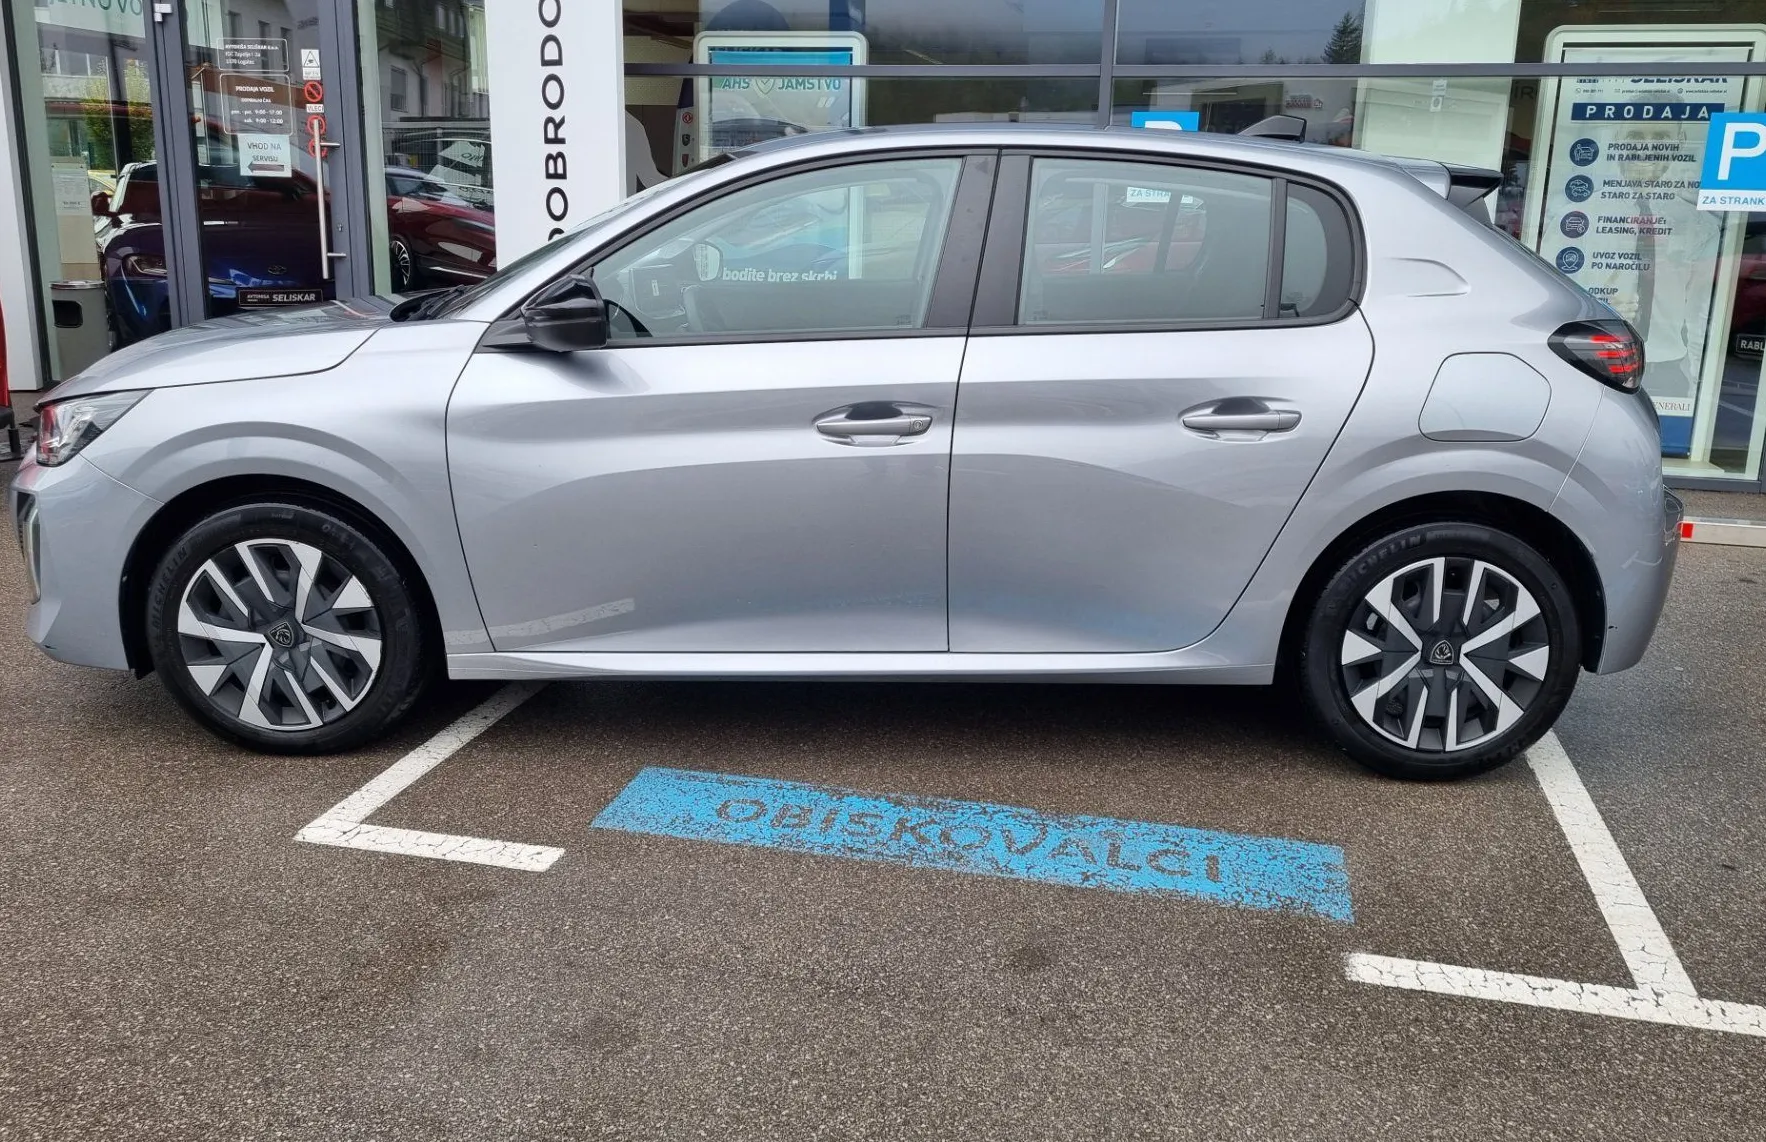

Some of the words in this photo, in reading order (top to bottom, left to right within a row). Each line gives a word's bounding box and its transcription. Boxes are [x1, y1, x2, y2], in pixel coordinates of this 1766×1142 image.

[722, 77, 750, 90] AHS
[777, 77, 842, 91] JAMSTVO
[1585, 105, 1710, 119] PRODAJA
[247, 142, 268, 150] VHOD
[270, 142, 282, 151] NA
[1607, 142, 1650, 152] PRODAJA
[1651, 143, 1680, 152] NOVIH
[1717, 122, 1766, 181] P
[1606, 154, 1616, 162] IN
[1618, 154, 1670, 162] RABLJENIH
[1672, 154, 1697, 162] VOZIL
[1602, 179, 1642, 188] MENJAVA
[1644, 180, 1673, 188] STARO
[1674, 180, 1686, 188] ZA
[1687, 180, 1701, 189] NO
[1600, 191, 1630, 199] STARO
[1632, 192, 1643, 200] ZA
[1644, 192, 1675, 200] STARO
[1702, 196, 1716, 204] ZA
[1719, 196, 1766, 206] STRANK
[1597, 215, 1667, 224] FINANCIRANJE:
[1596, 227, 1637, 236] LEASING,
[1639, 227, 1673, 236] KREDIT
[1592, 252, 1616, 260] UVOZ
[1617, 252, 1642, 260] VOZIL
[1591, 262, 1603, 270] PO
[1605, 260, 1650, 271] NAROČILU
[722, 268, 766, 282] bodite
[767, 269, 799, 282] brez
[801, 270, 838, 281] skrbi
[1588, 287, 1619, 295] ODKUP
[1652, 402, 1692, 412] ENERALI
[715, 798, 1223, 884] OBISKOVALCI
